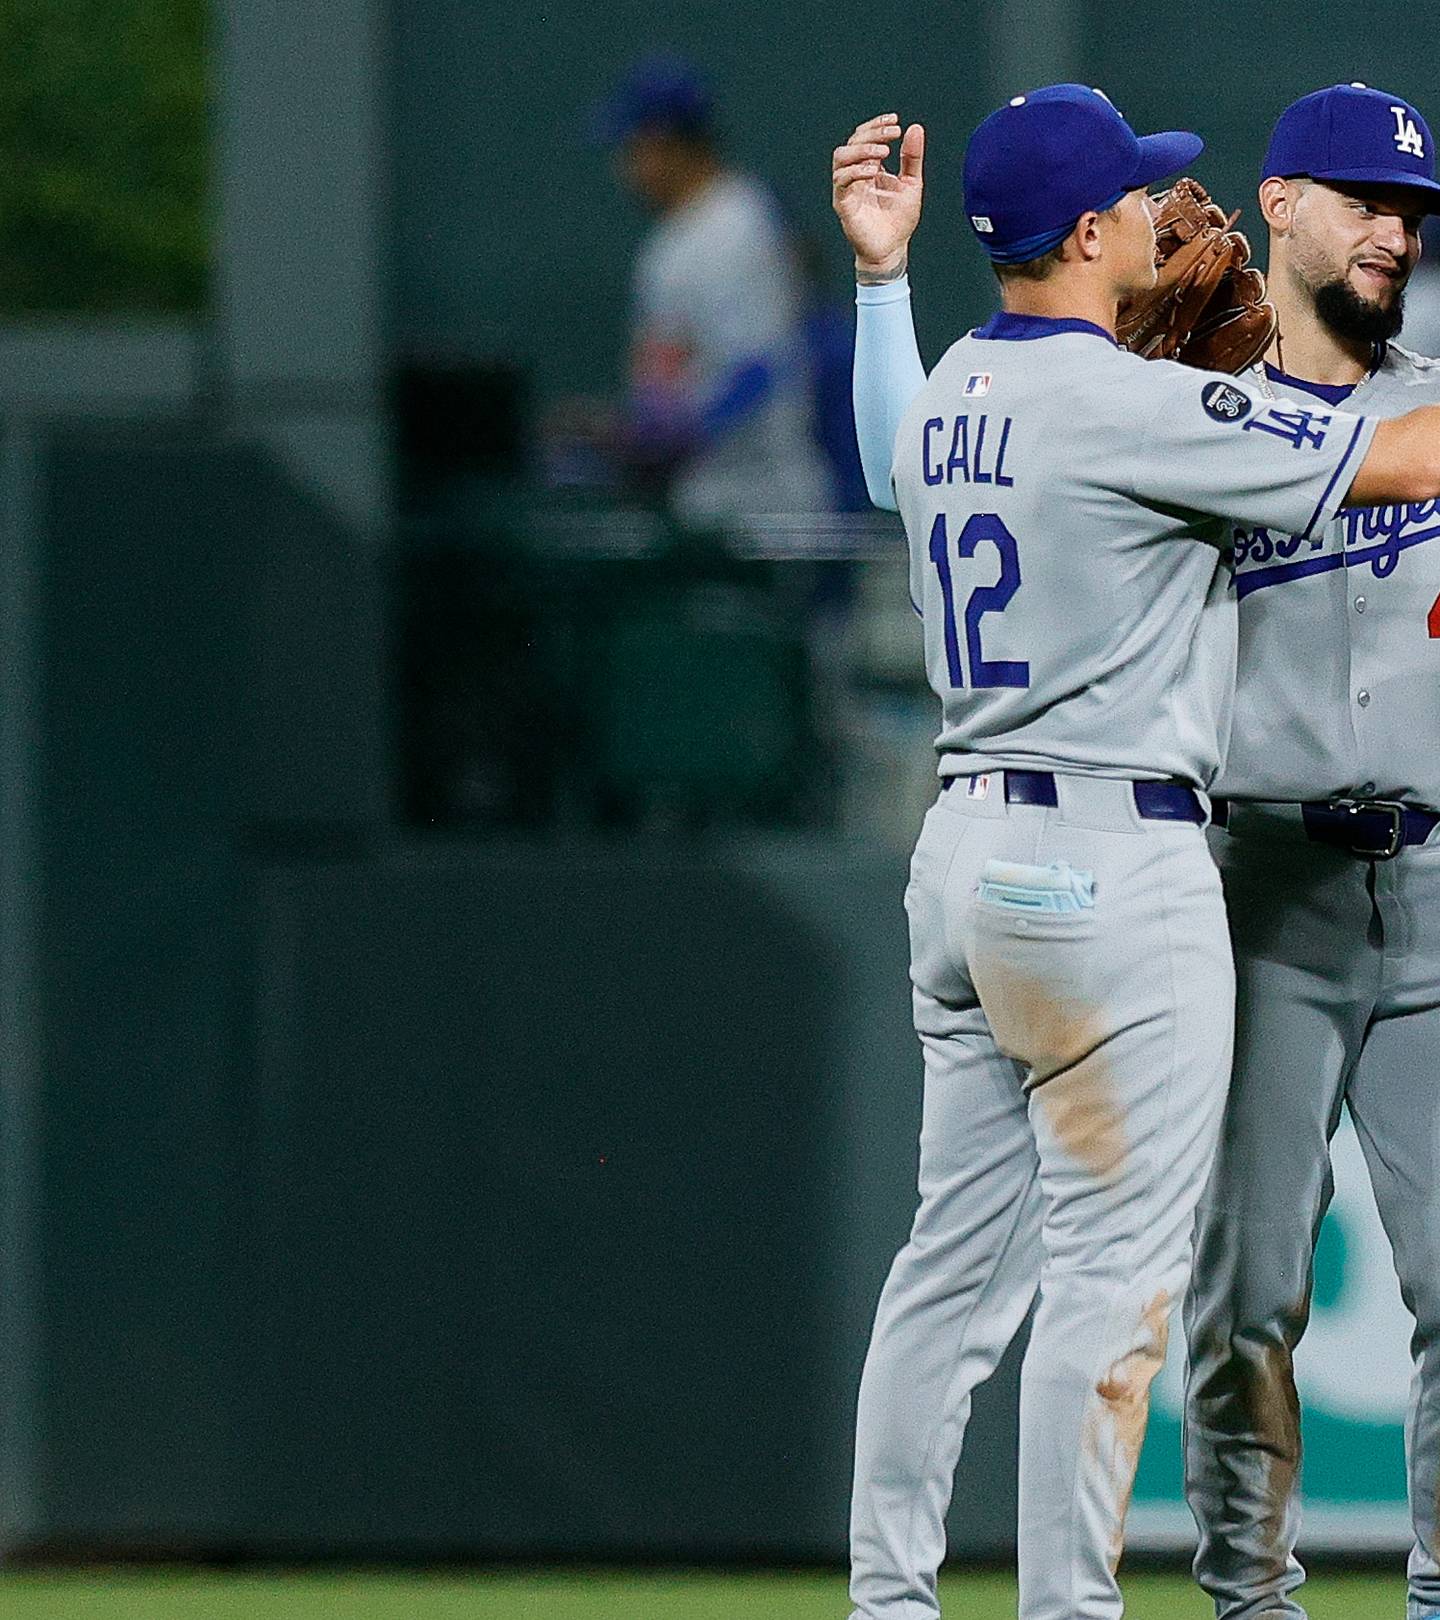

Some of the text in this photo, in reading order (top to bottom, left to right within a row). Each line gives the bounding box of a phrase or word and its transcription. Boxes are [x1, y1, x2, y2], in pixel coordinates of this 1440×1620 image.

[1390, 106, 1425, 158] LA
[1215, 388, 1247, 417] 34
[923, 414, 1014, 487] CALL
[1242, 409, 1332, 450] LA
[929, 513, 1030, 689] 12
